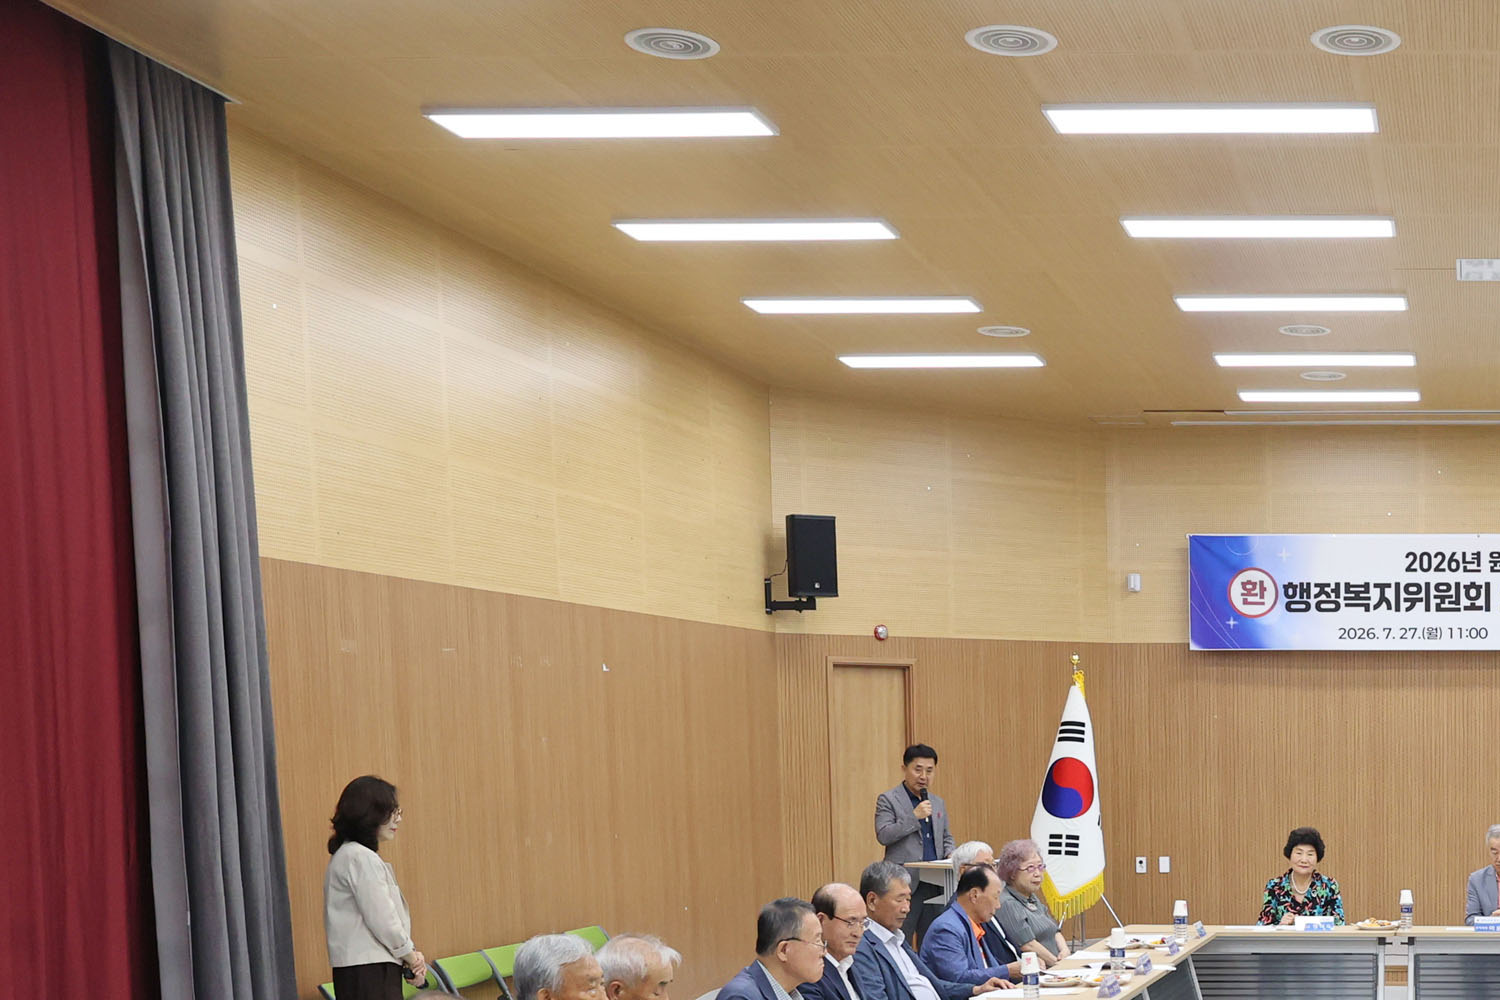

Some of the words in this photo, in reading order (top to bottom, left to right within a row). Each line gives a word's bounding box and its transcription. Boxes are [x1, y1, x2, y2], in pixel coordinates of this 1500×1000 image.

[1404, 550, 1482, 573] 2026년
[1240, 579, 1267, 606] 환
[1282, 581, 1491, 613] 행정복지위원회
[1338, 627, 1379, 640] 2026.
[1382, 627, 1396, 640] 7.
[1399, 626, 1443, 640] 27.(월)
[1447, 627, 1489, 640] 11:00
